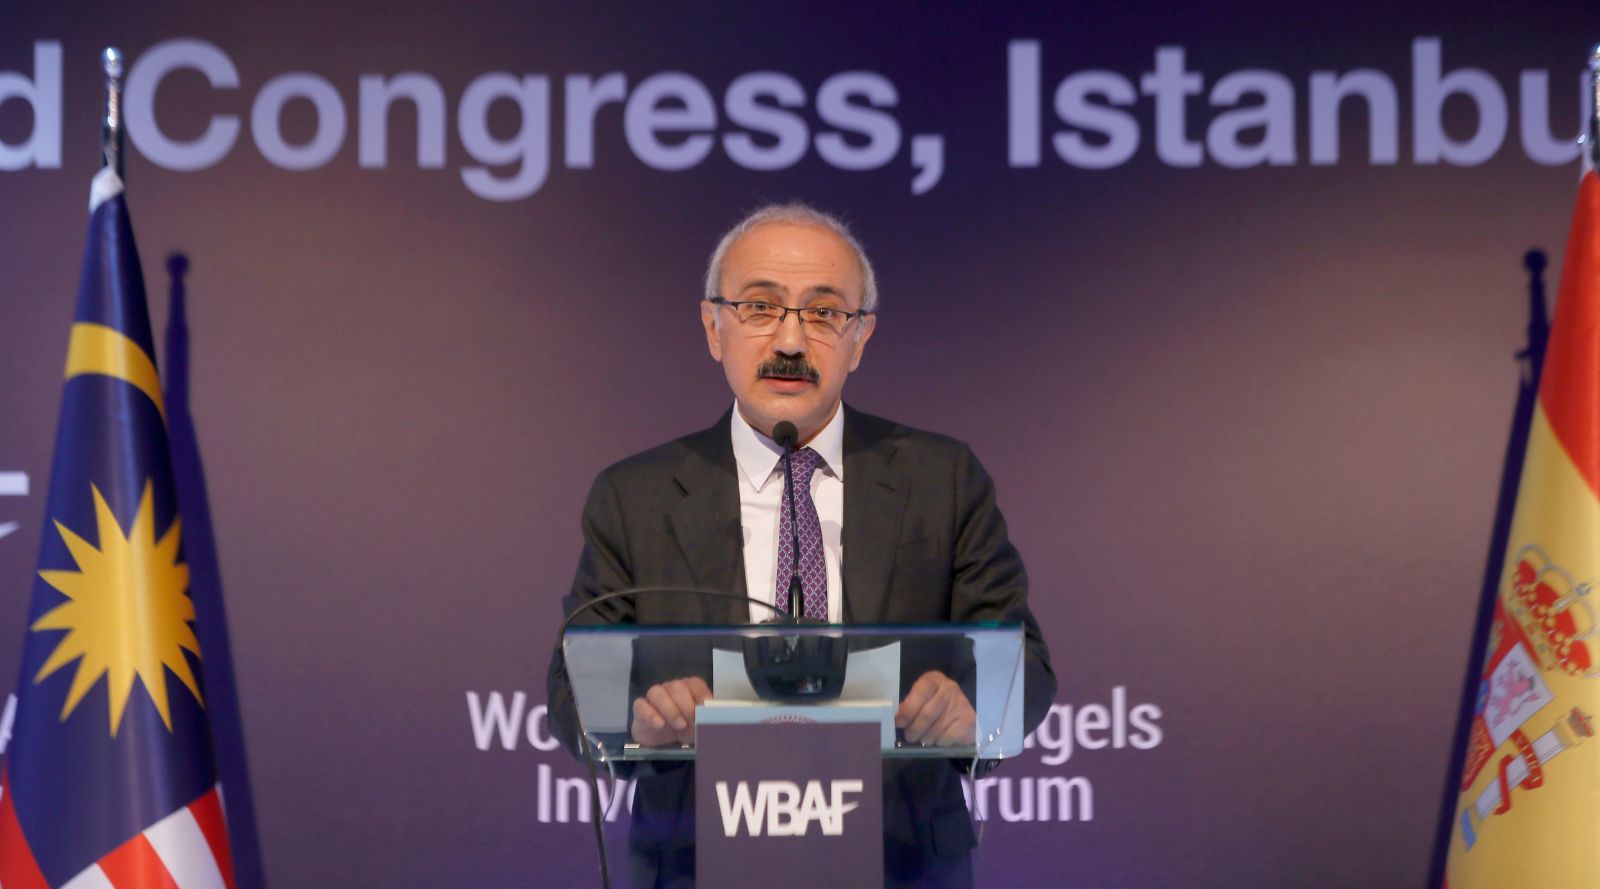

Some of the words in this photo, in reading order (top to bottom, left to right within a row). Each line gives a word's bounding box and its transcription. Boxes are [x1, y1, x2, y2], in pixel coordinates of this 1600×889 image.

[122, 38, 944, 201] Congress,
[1024, 686, 1163, 765] gels
[715, 780, 863, 837] WBAF
[961, 776, 1095, 822] rum
